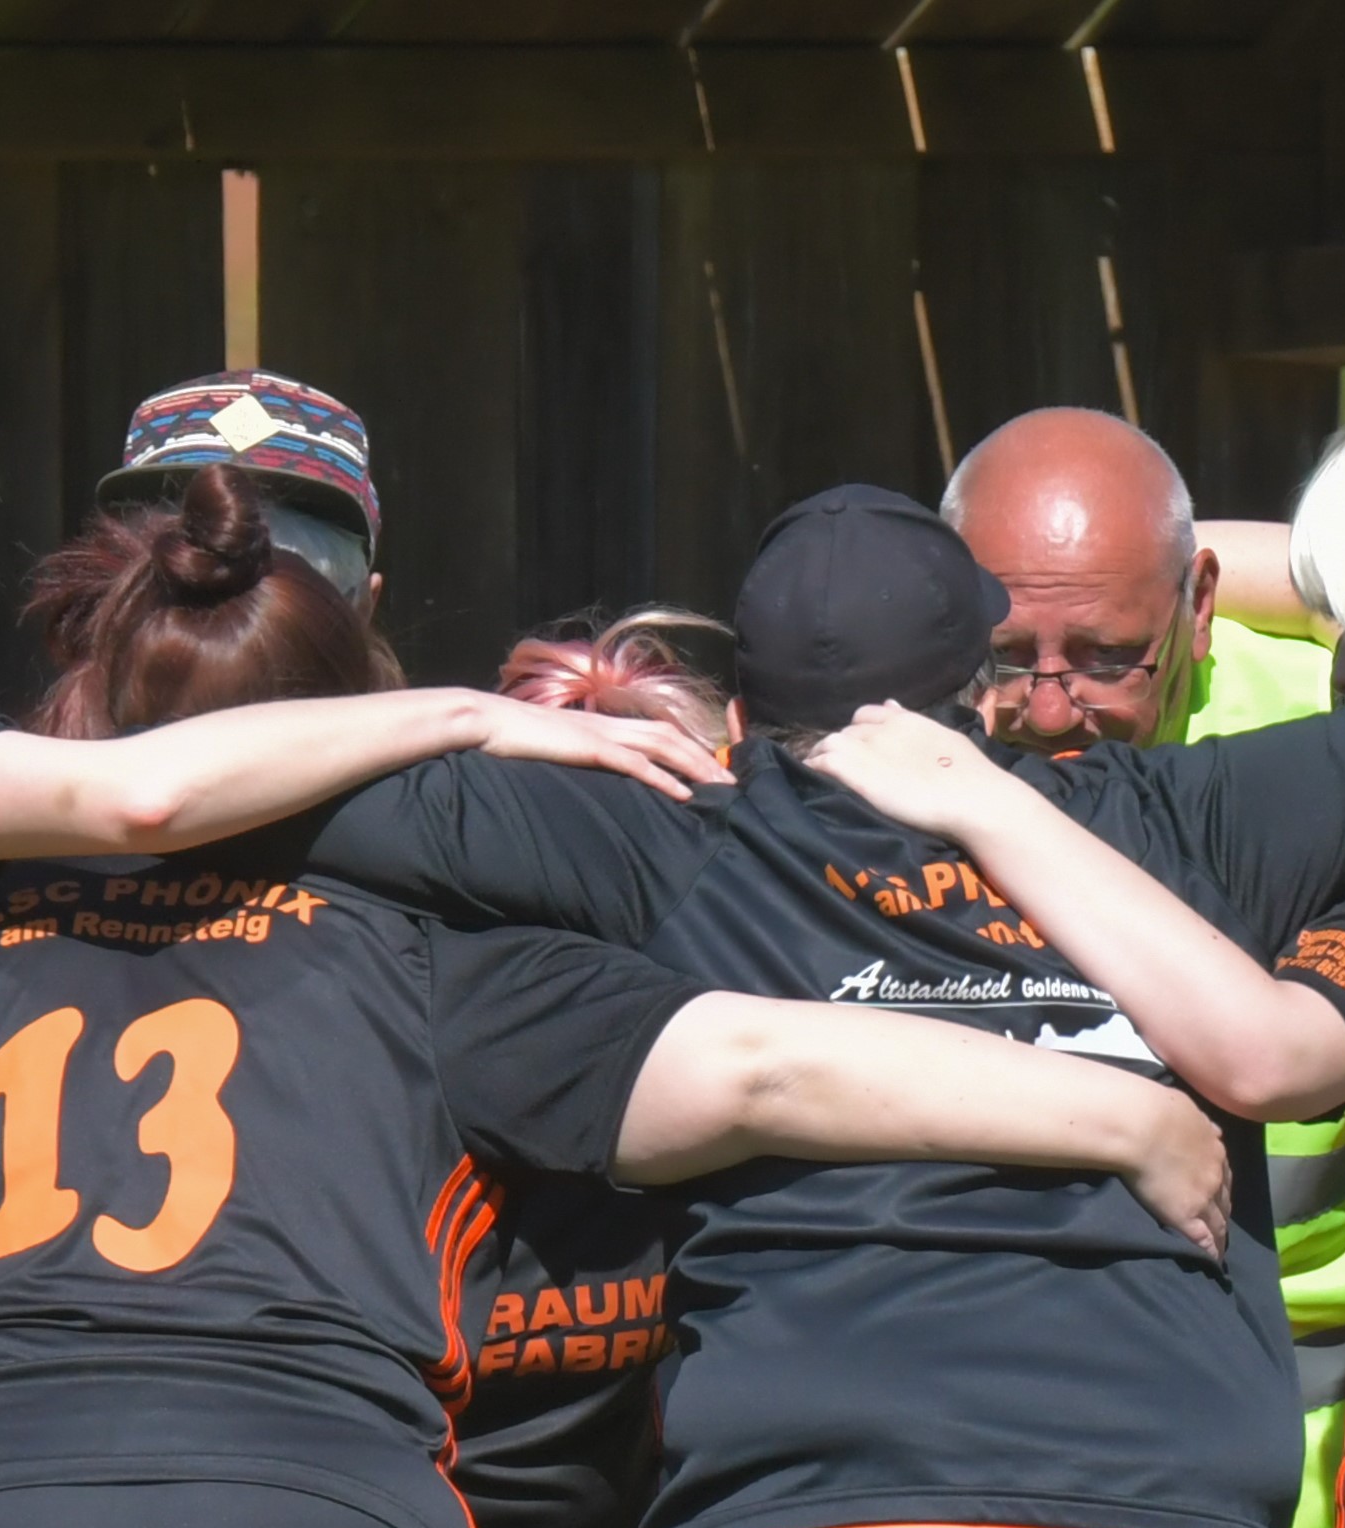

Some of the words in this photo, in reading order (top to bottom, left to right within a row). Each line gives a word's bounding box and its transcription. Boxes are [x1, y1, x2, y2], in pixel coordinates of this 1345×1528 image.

[103, 872, 329, 926] PHÖNIX
[72, 909, 271, 943] Rennsteig
[830, 959, 1012, 1001] Altstadthotel
[486, 1273, 667, 1336] RAUM
